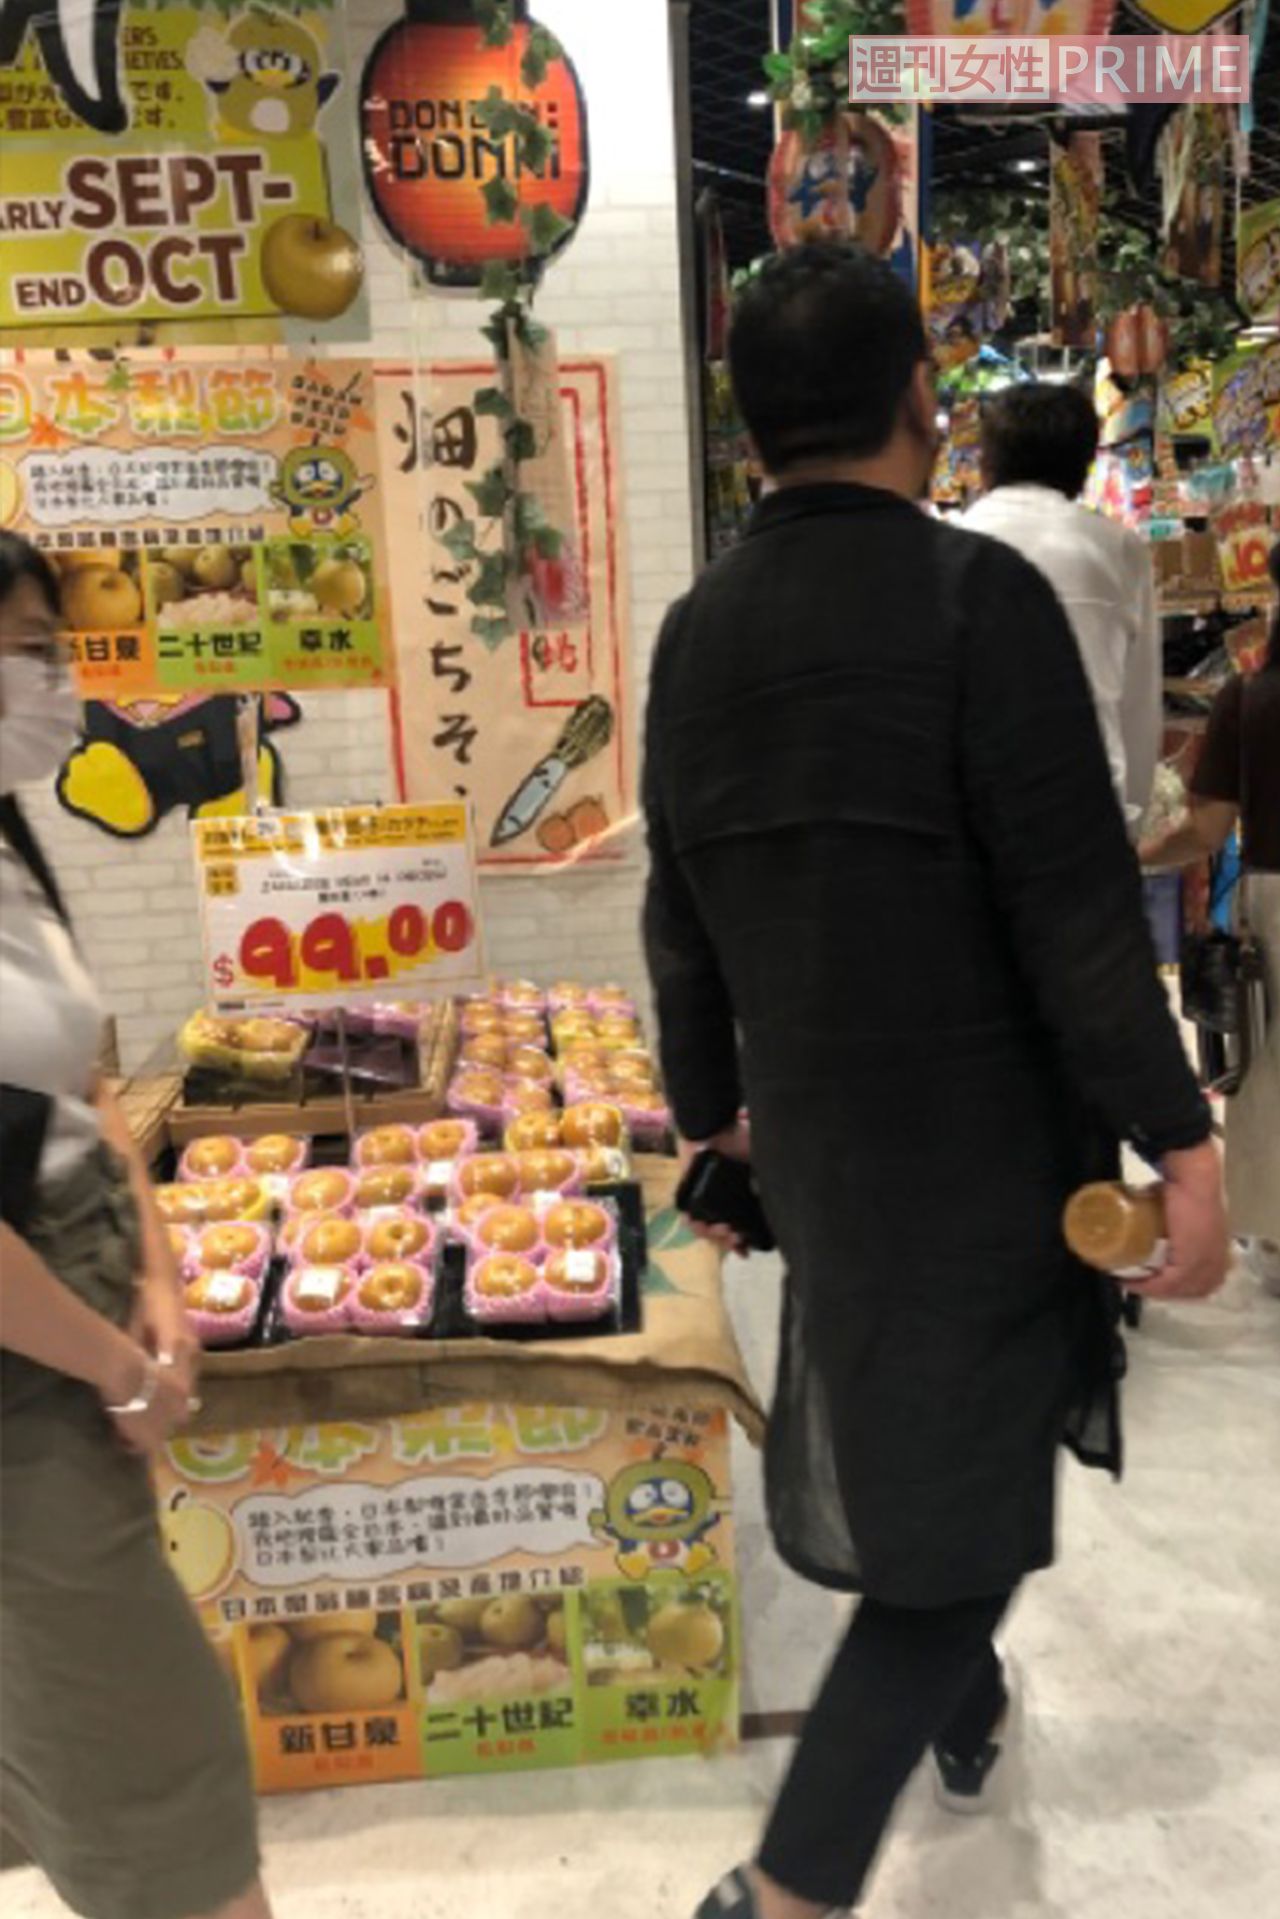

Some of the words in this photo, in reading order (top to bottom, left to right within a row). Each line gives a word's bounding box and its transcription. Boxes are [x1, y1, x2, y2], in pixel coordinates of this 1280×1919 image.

[390, 101, 463, 129] DON
[0, 203, 64, 230] RLY
[67, 155, 291, 229] SEPT-
[15, 279, 85, 307] END
[87, 234, 244, 305] OCT
[159, 632, 261, 658] 二十世紀
[212, 901, 474, 988] $99.00
[427, 1698, 574, 1742] 二十世紀
[626, 1688, 700, 1722] 幸水
[279, 1714, 400, 1754] 新甘泉
